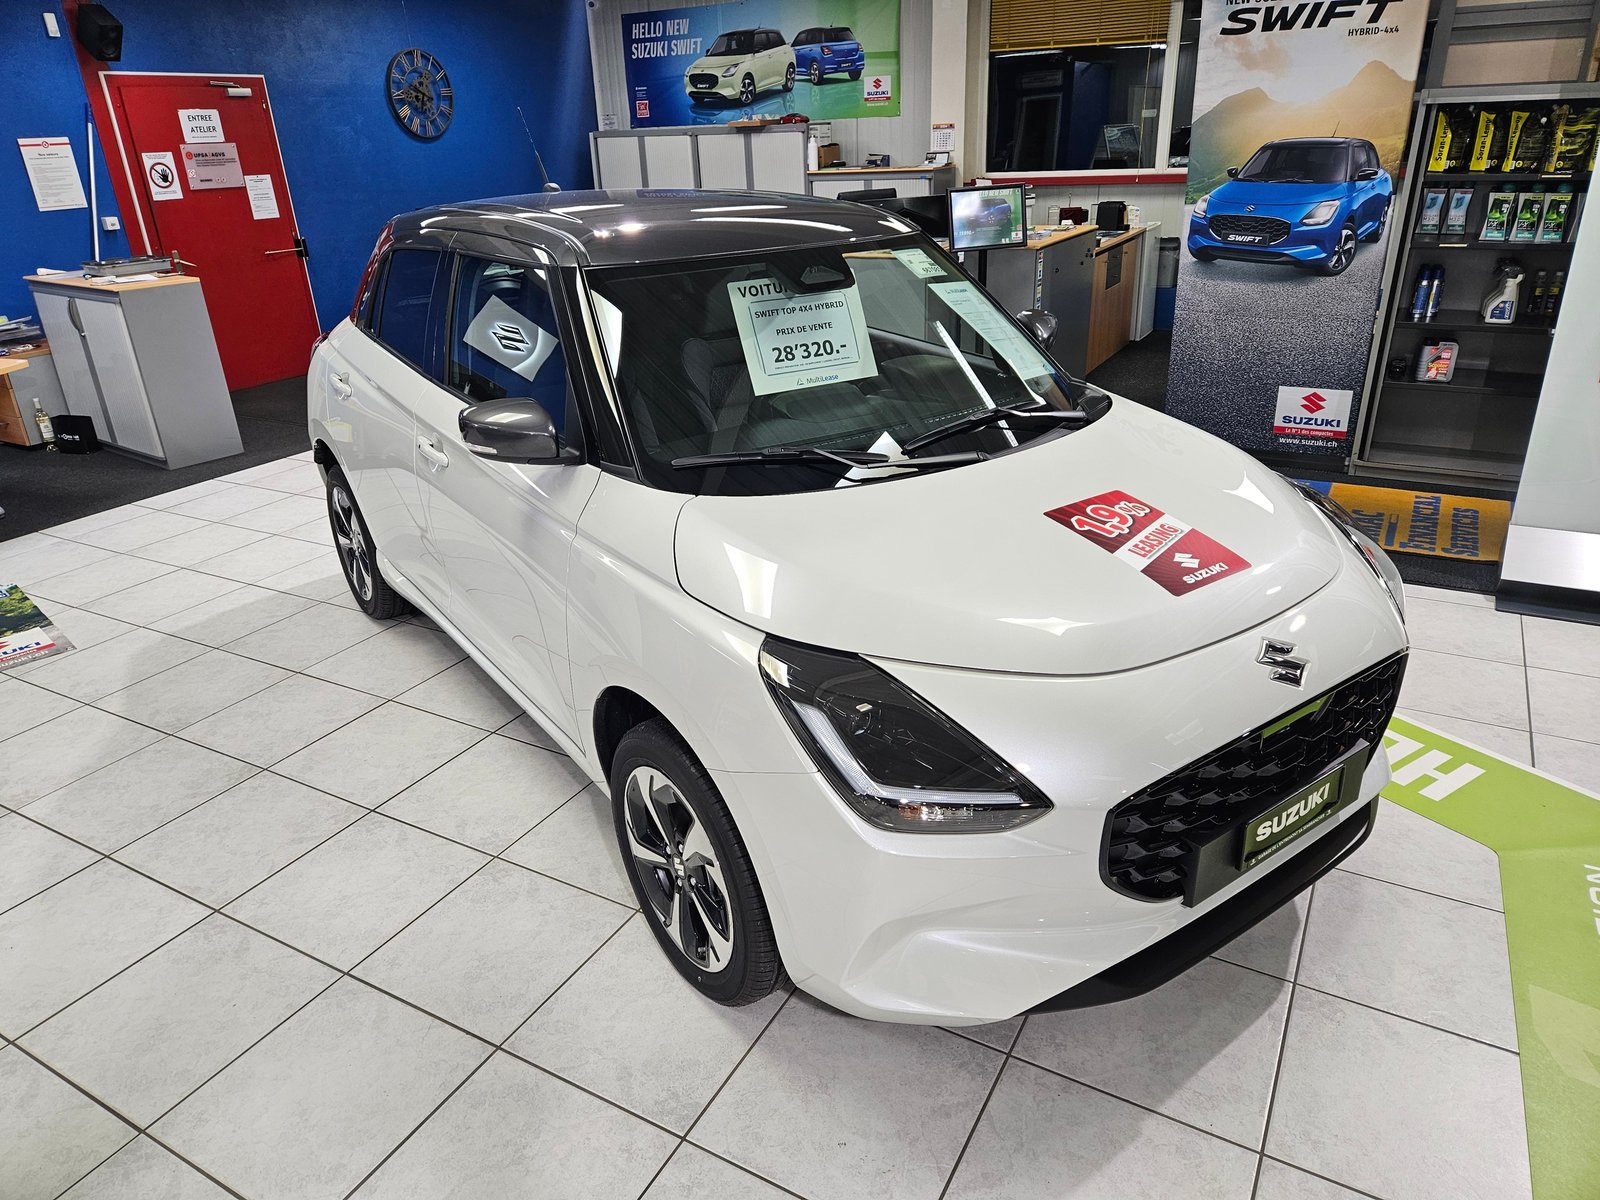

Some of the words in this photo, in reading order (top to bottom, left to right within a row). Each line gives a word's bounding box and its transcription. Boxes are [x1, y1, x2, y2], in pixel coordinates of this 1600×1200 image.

[1220, 0, 1403, 35] SWIFT
[632, 21, 662, 39] HELLO
[666, 19, 689, 36] NEW
[1348, 25, 1399, 36] HYBRID-4x4
[632, 41, 667, 59] SUZUKI
[671, 38, 702, 56] SWIFT
[1227, 234, 1262, 243] SWIFT
[754, 309, 780, 319] SWIFT
[782, 306, 797, 316] TOP
[798, 304, 813, 313] 4X4
[815, 300, 844, 312] HYBRID
[776, 327, 796, 336] PRIX
[809, 321, 833, 331] VENTE
[771, 339, 847, 363] 28'320.-
[806, 374, 839, 385] MultiLease
[1282, 415, 1341, 428] SUZUKI
[1279, 437, 1338, 447] www.suzuki.ch
[1127, 523, 1183, 559] LEASING
[1182, 562, 1229, 585] SUZUKI
[1255, 782, 1331, 842] SUZUKI
